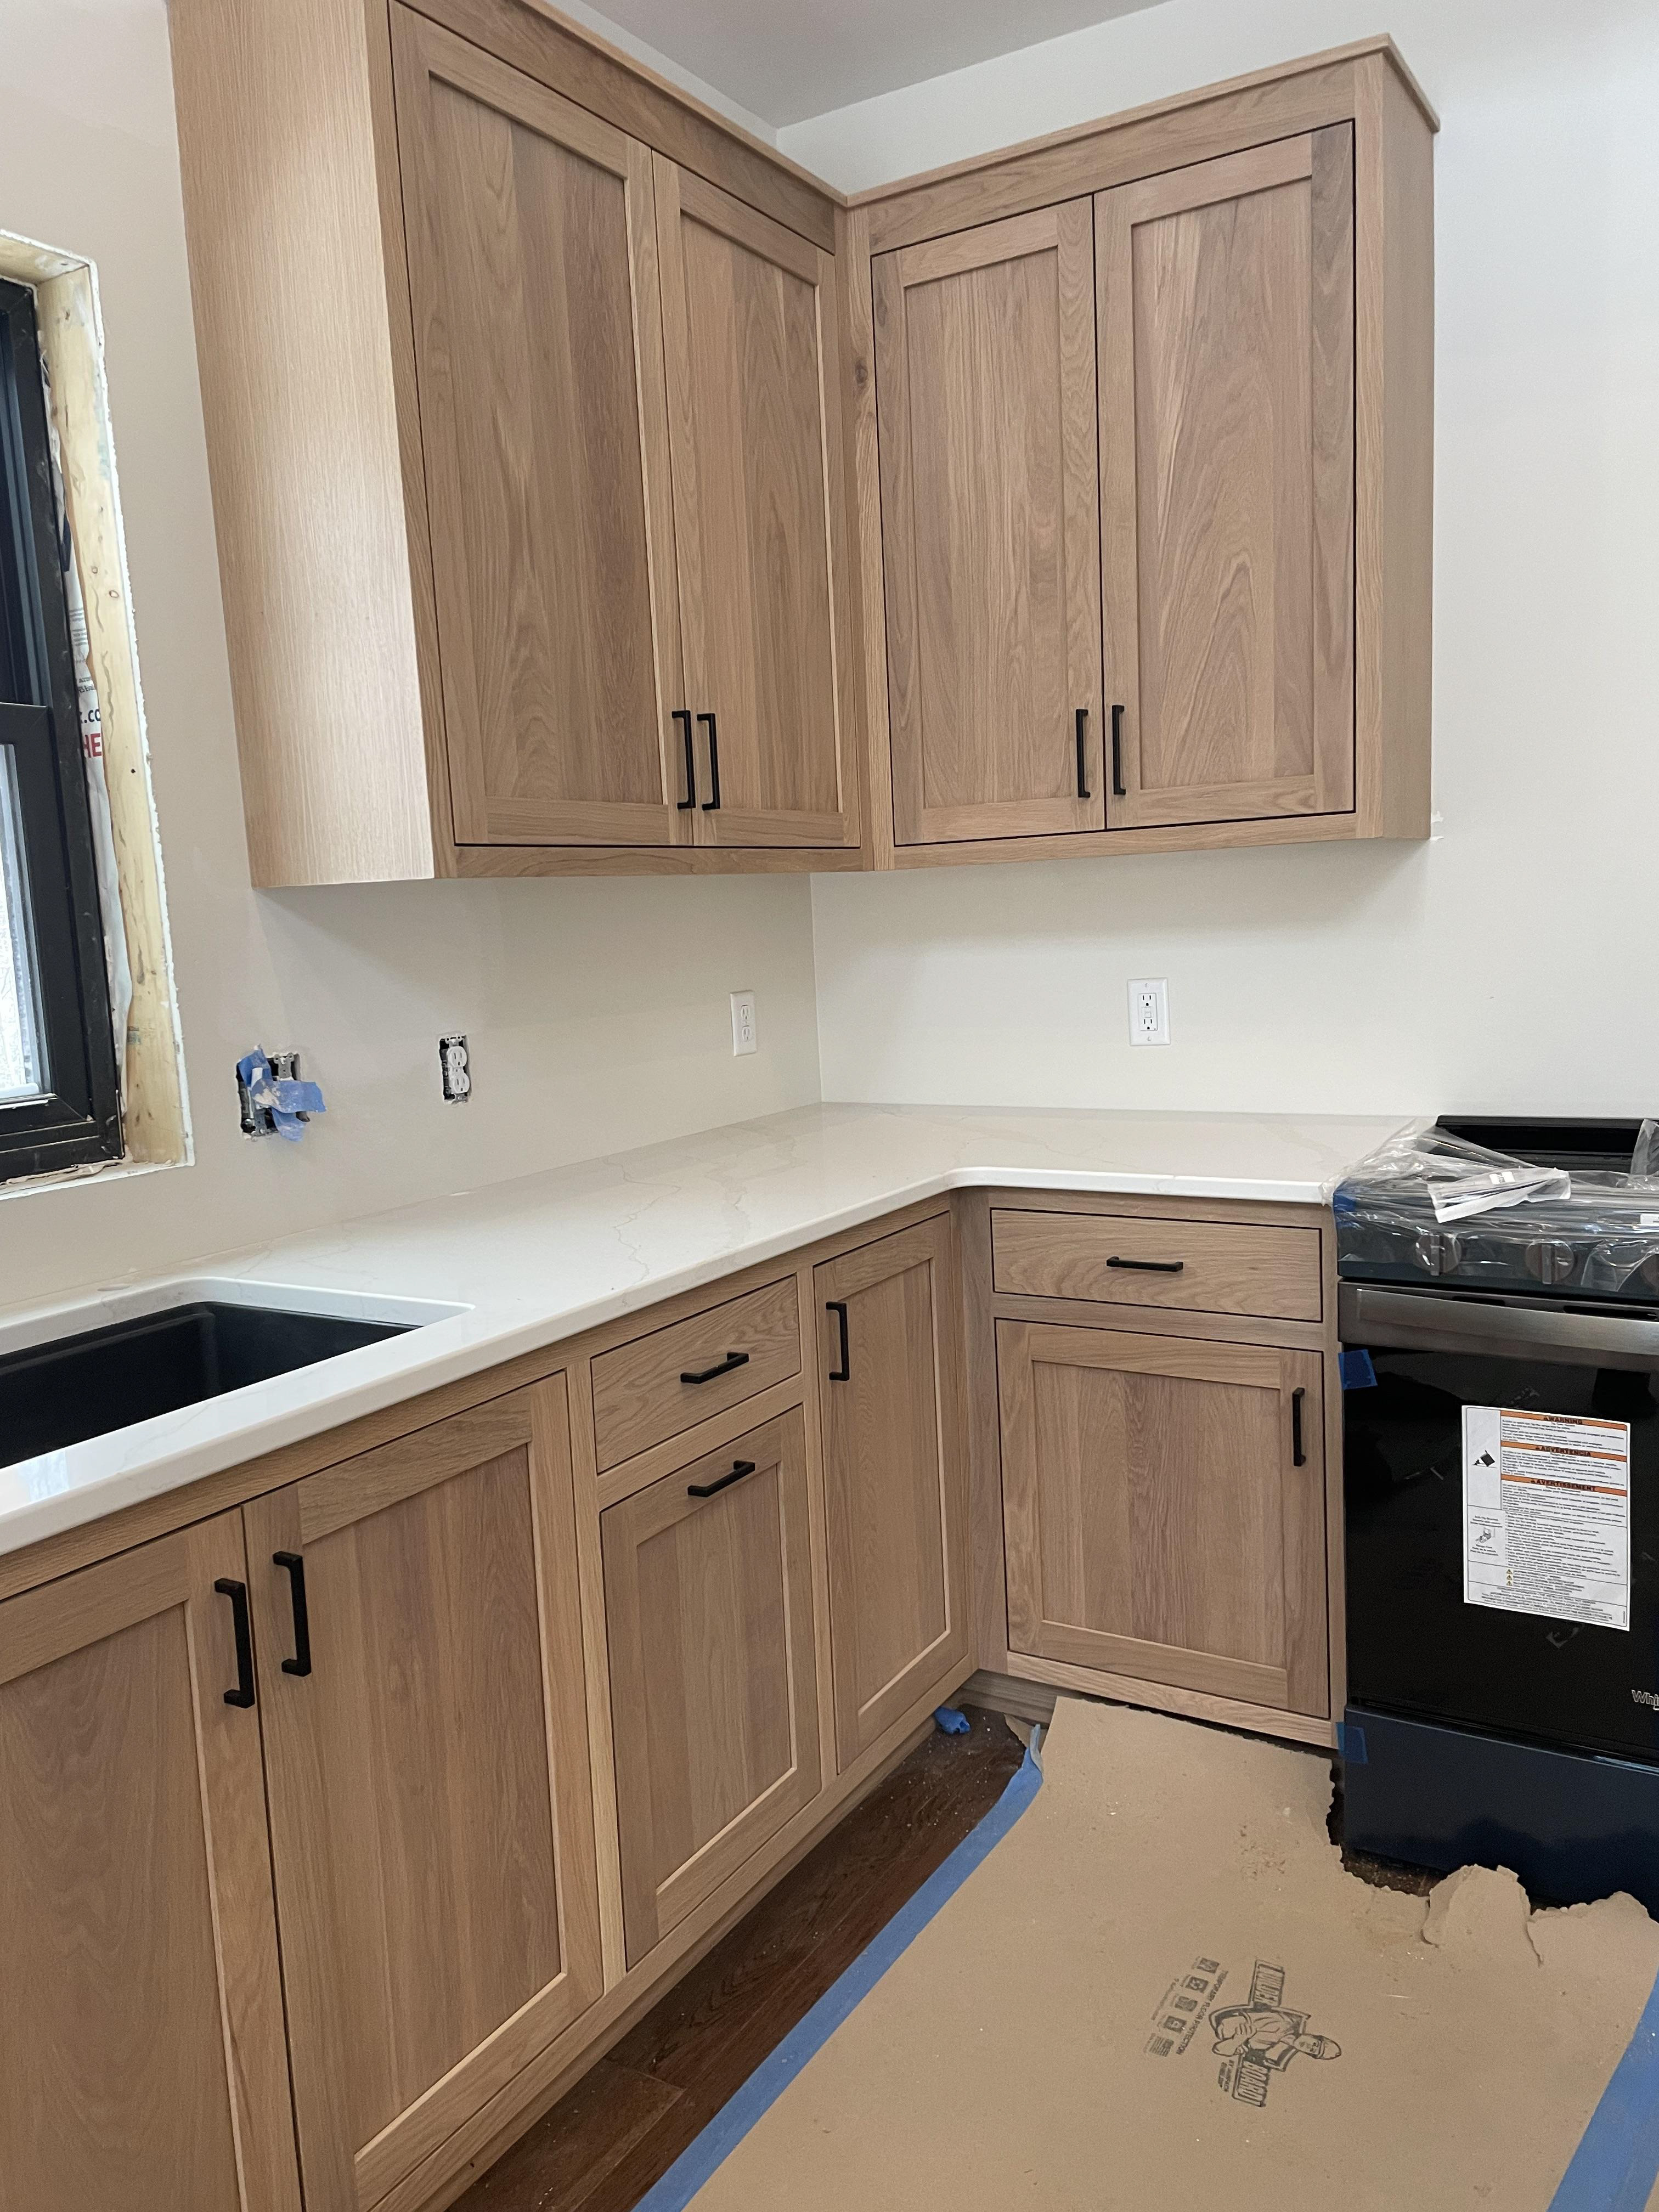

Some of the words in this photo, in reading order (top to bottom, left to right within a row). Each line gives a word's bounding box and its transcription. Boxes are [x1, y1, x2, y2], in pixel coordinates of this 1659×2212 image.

[1548, 1416, 1583, 1425] WARNING
[1541, 1446, 1592, 1457] ADVERTENCIA
[1534, 1480, 1596, 1492] AVERTISSEMENT
[1176, 2019, 1200, 2055] PROTECTION
[1238, 2061, 1268, 2103] BOARD
